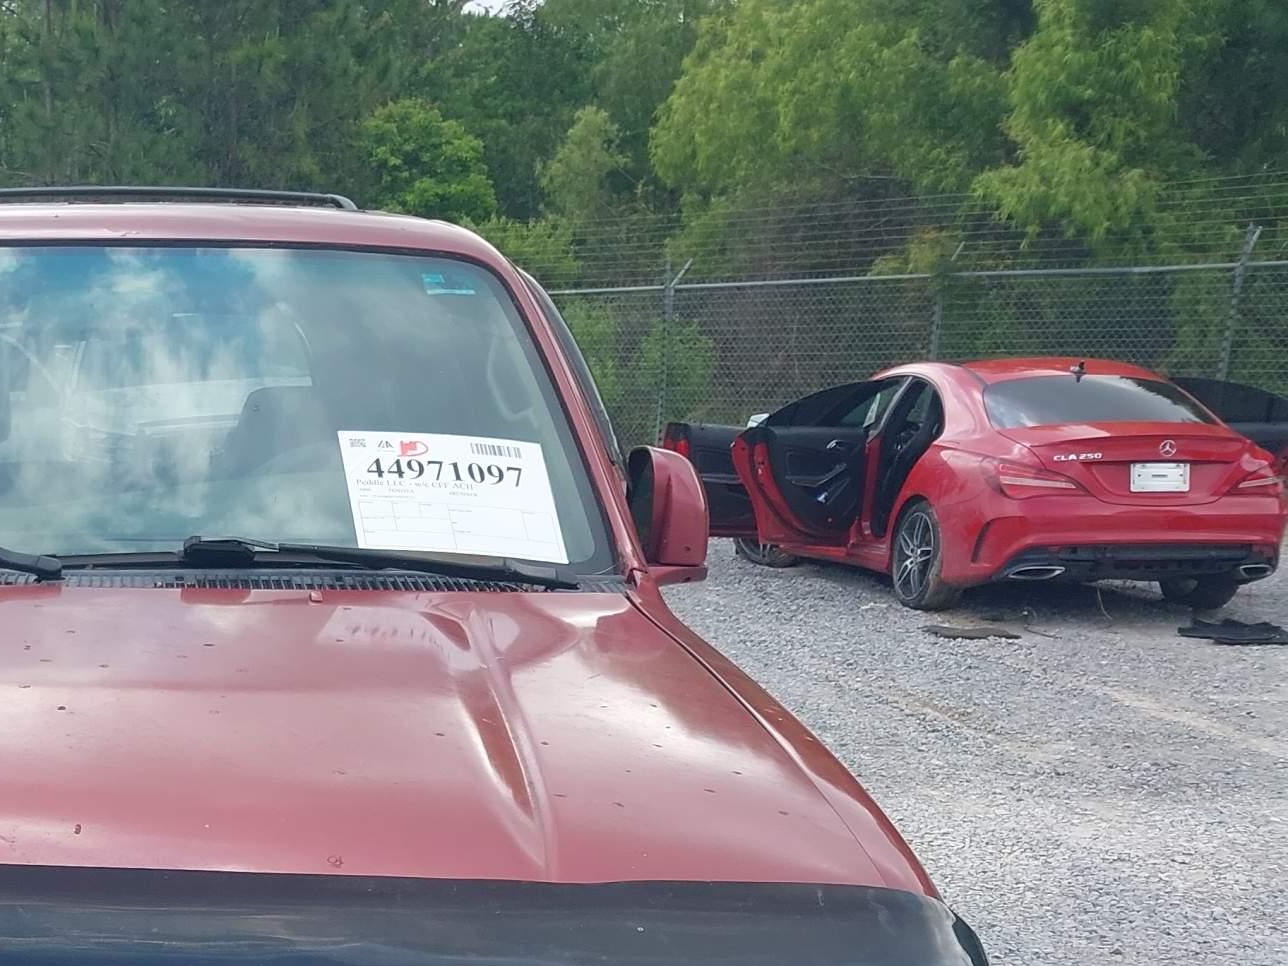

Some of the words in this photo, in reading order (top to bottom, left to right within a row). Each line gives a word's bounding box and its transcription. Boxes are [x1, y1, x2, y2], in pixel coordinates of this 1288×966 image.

[1053, 453, 1077, 461] CLA
[1079, 452, 1103, 460] 250
[366, 457, 523, 488] 44971097
